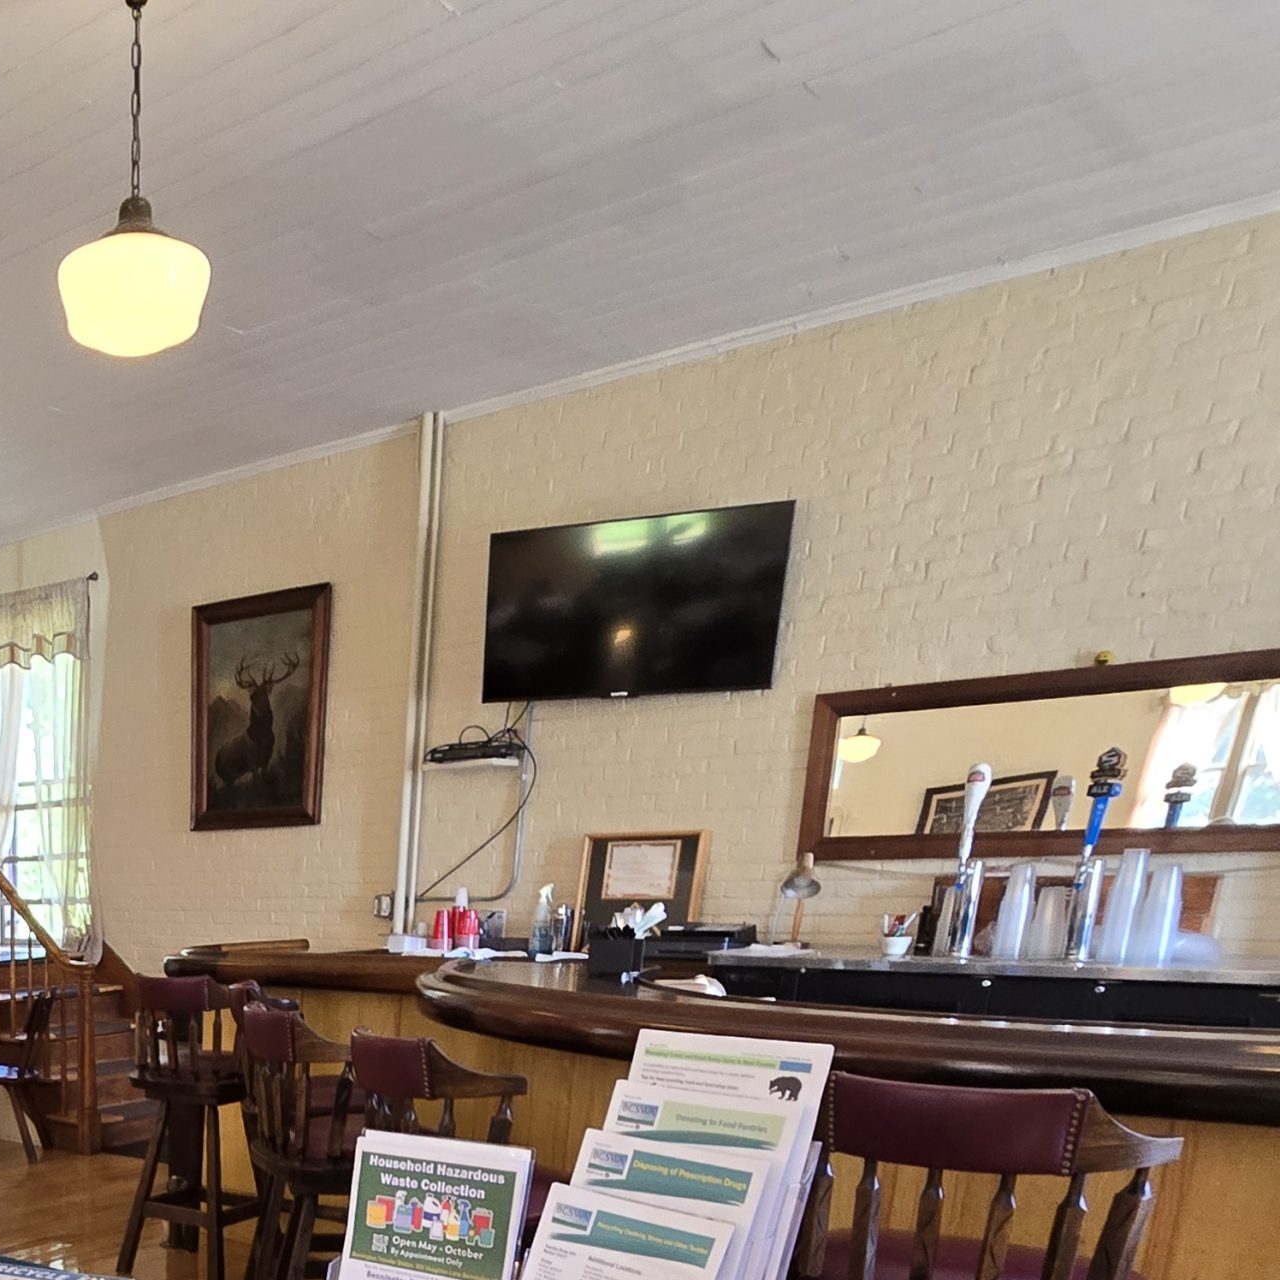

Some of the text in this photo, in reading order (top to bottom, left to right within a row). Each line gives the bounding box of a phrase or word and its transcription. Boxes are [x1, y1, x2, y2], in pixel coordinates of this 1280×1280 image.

[675, 1113, 768, 1134] Donating to Food Pantries
[369, 1154, 505, 1184] Household Hazardous
[633, 1159, 747, 1191] Disposing of Prescription Drugs
[380, 1173, 485, 1199] Waste Collection
[390, 1247, 463, 1268] By Appointment Only
[392, 1236, 417, 1249] Open
[418, 1240, 437, 1253] May
[444, 1245, 484, 1260] October
